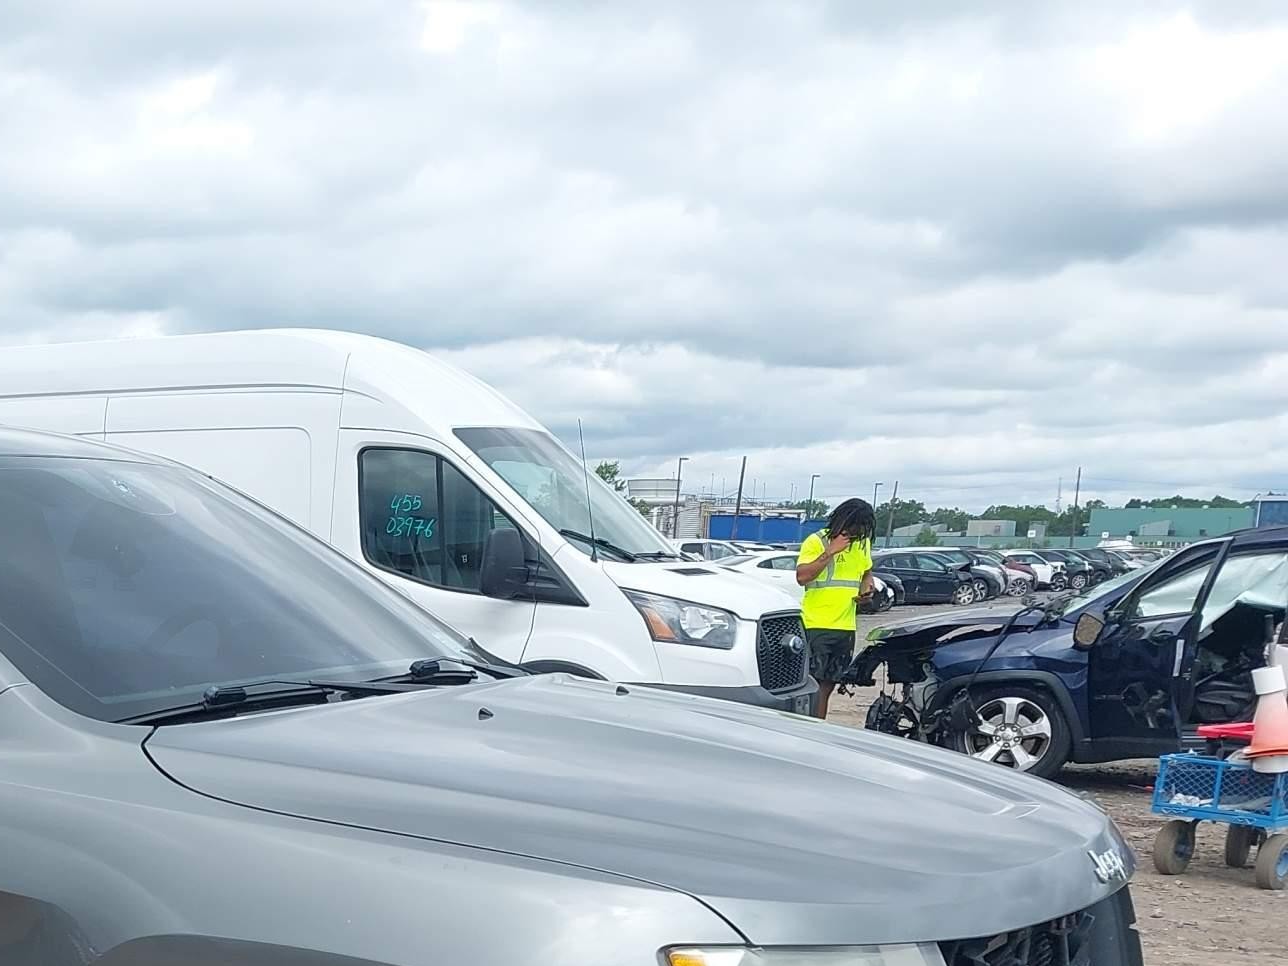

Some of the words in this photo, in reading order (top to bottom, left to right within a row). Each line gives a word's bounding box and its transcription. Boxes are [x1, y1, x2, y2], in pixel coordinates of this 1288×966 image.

[391, 494, 422, 514] 455
[386, 516, 436, 538] 03976
[1087, 848, 1127, 882] Jeep
